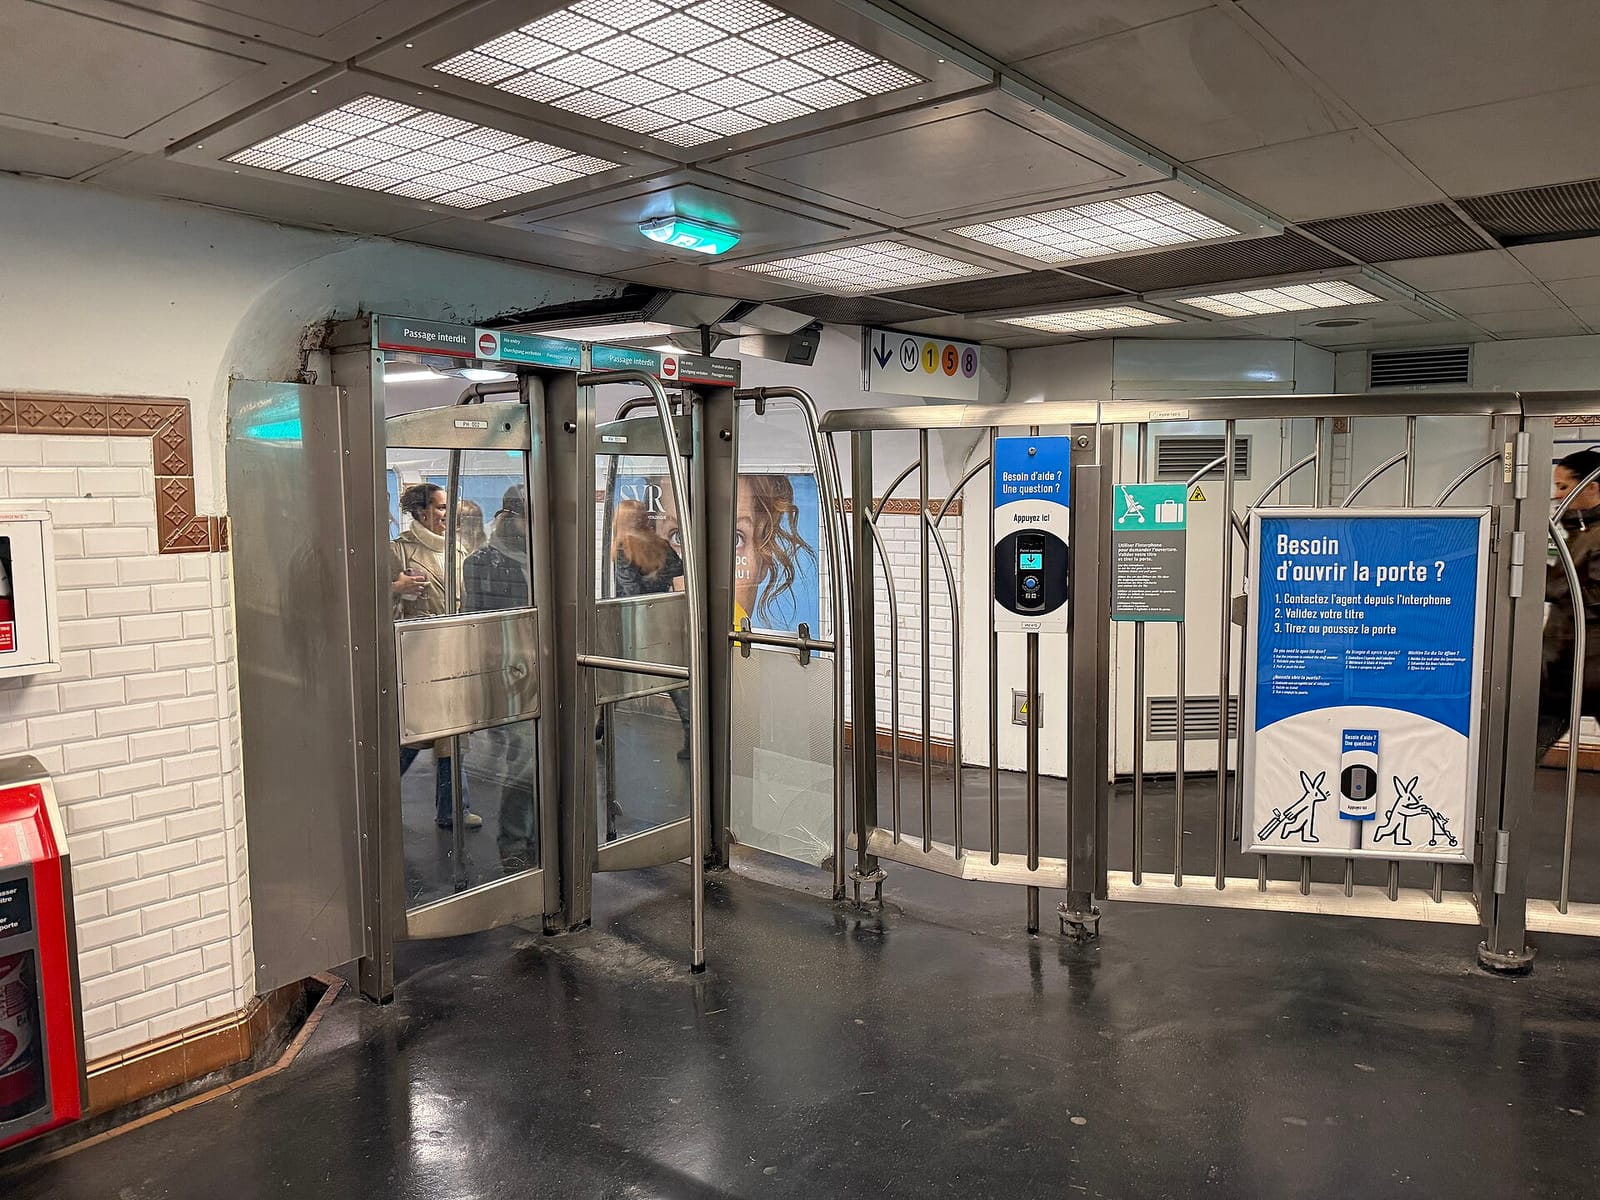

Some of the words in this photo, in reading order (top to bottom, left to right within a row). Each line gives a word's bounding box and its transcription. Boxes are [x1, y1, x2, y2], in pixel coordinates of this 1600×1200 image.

[404, 328, 436, 341] Passage
[437, 332, 466, 344] interdit
[609, 355, 633, 365] Passage
[634, 358, 655, 367] interdit
[1003, 471, 1029, 481] Besoin
[1031, 471, 1055, 481] d'aide
[1057, 471, 1062, 480] ?
[1003, 484, 1017, 494] Une
[1020, 484, 1053, 496] question
[1056, 483, 1060, 493] ?
[620, 484, 667, 513] SVR
[1013, 513, 1040, 523] Appuyez
[1277, 534, 1339, 555] Besoin
[1276, 560, 1347, 582] d'ouvrir
[1353, 560, 1369, 582] la
[1377, 561, 1427, 586] porte
[1434, 561, 1446, 582] ?
[1275, 594, 1281, 604] 1.
[1284, 594, 1328, 604] Contactez
[1331, 594, 1362, 607] l'agent
[1364, 594, 1394, 607] depuis
[1274, 608, 1283, 619] 2.
[1285, 608, 1317, 619] Validez
[1320, 610, 1342, 619] votre
[1345, 609, 1364, 619] titre
[1274, 623, 1282, 633] 3.
[1285, 623, 1306, 633] Tirez
[1309, 625, 1320, 634] ou
[1322, 625, 1358, 636] poussez
[1362, 624, 1369, 634] la
[1372, 624, 1397, 637] porte
